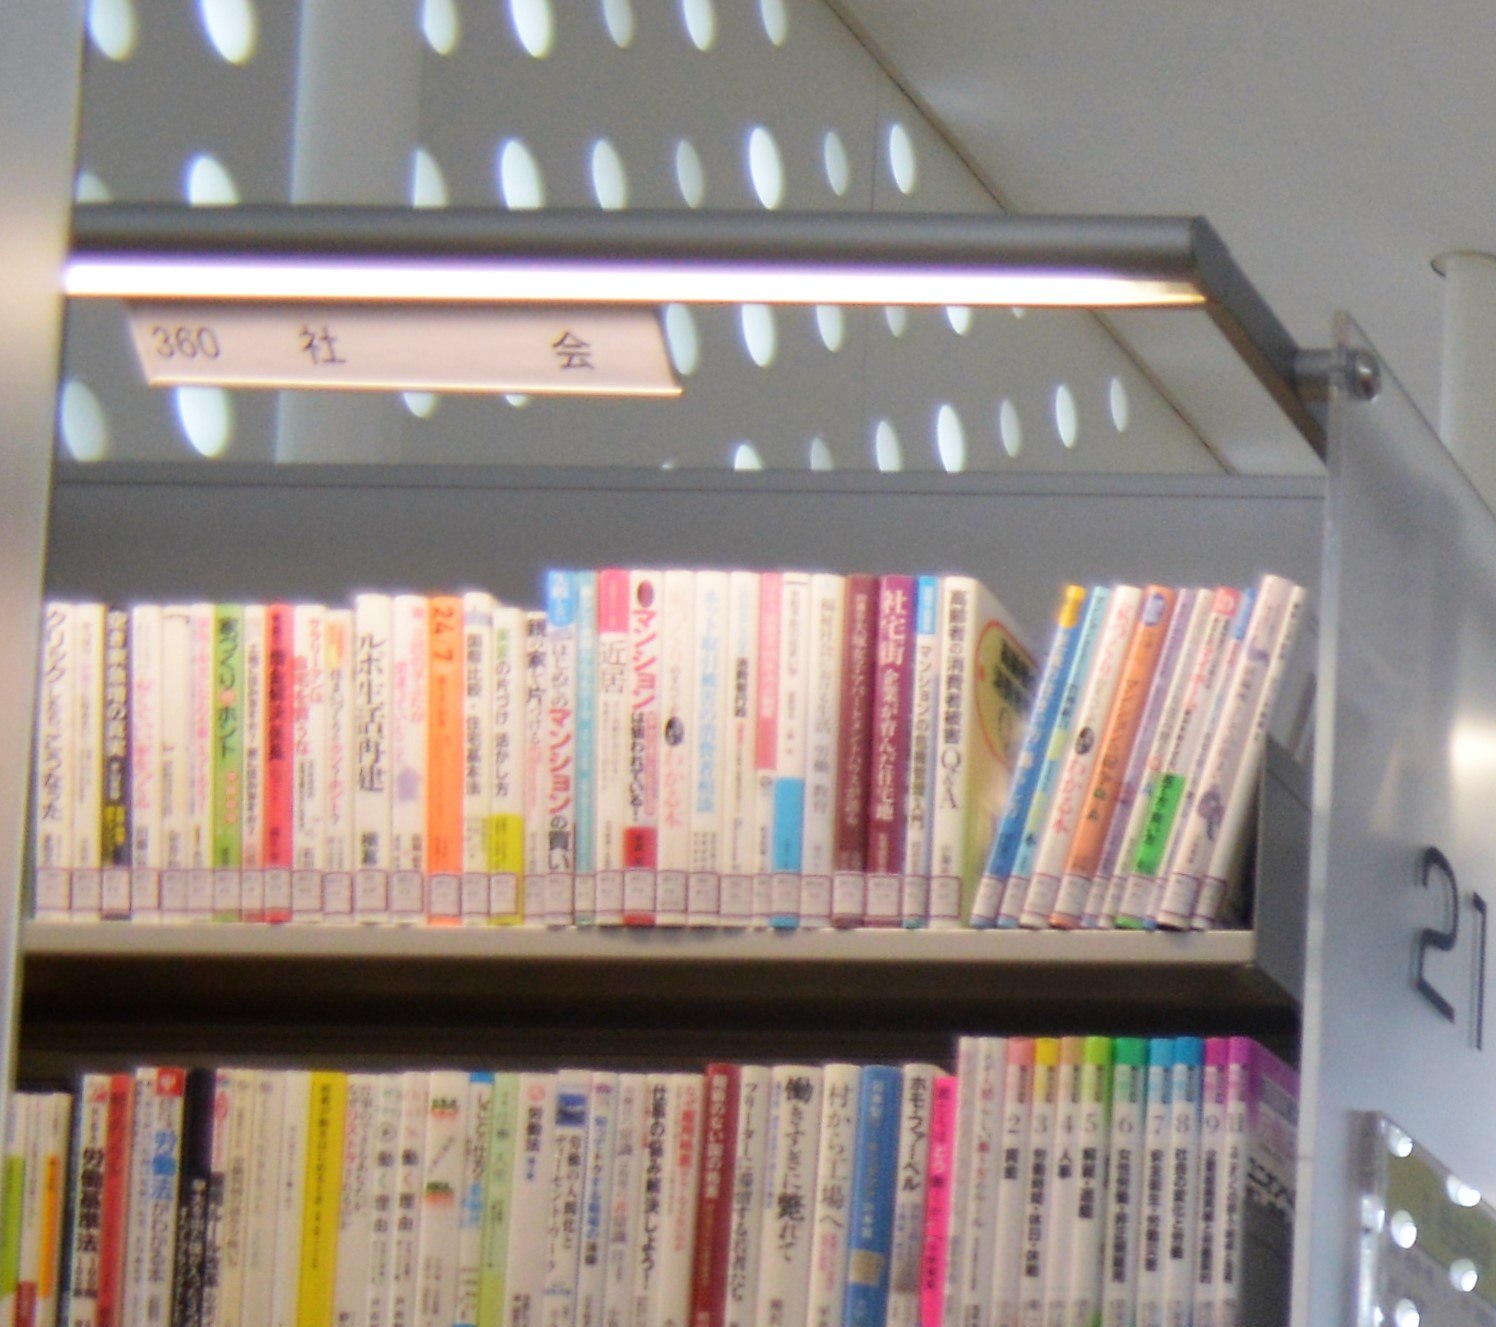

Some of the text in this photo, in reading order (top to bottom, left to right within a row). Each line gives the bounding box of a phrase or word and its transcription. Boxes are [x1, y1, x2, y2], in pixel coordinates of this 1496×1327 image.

[151, 325, 595, 371] 360 社 会
[880, 590, 908, 668] 社宅街
[1411, 844, 1488, 1052] 21
[820, 1084, 852, 1230] 村から工場へ
